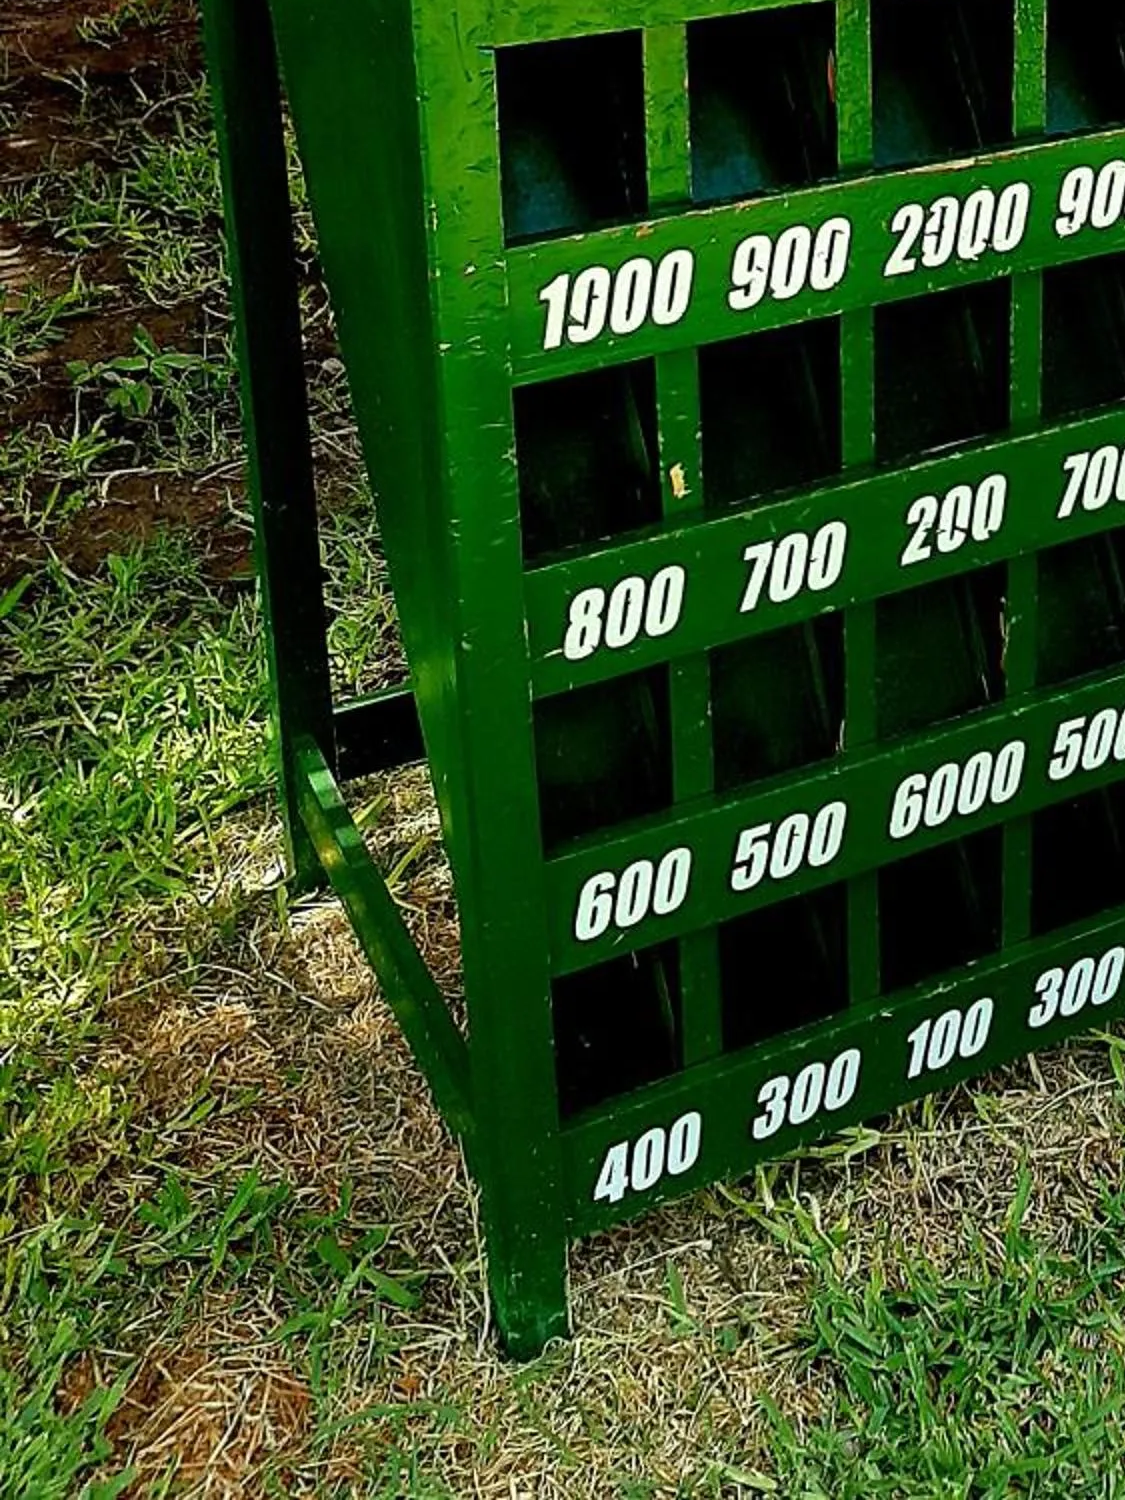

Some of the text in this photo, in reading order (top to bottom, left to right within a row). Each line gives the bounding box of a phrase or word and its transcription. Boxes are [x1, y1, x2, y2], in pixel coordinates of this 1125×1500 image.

[538, 248, 694, 351] 1000
[727, 216, 852, 311] 900
[882, 181, 1031, 278] 2000
[562, 564, 686, 661] 800
[739, 520, 848, 614] 700
[900, 473, 1008, 567] 200
[574, 846, 692, 942] 600
[730, 800, 848, 892] 500
[888, 739, 1026, 840] 6000
[592, 1110, 702, 1204] 400
[751, 1048, 862, 1140] 300
[906, 996, 995, 1080] 100
